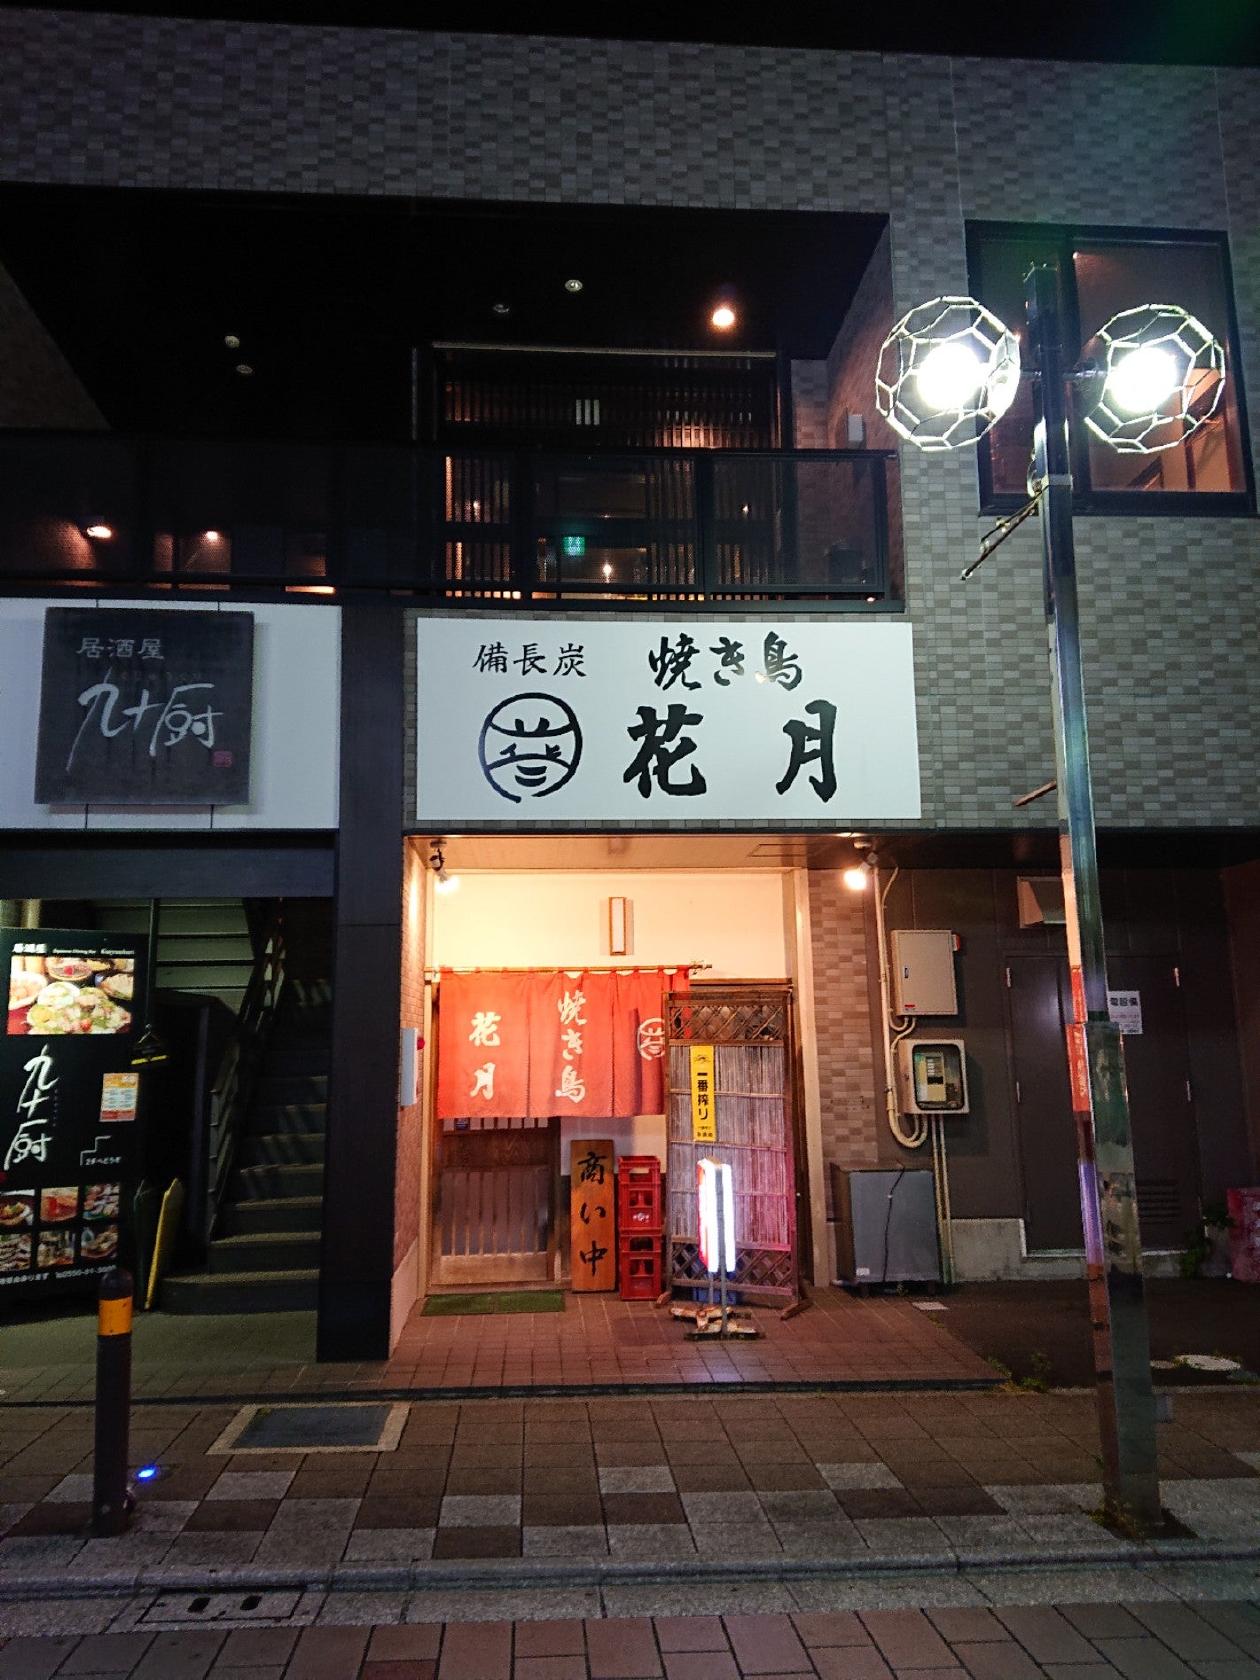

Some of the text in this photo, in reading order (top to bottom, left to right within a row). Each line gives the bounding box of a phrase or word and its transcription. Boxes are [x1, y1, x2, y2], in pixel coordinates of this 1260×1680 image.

[76, 637, 165, 660] 居酒屋
[472, 641, 587, 677] 備長炭
[648, 631, 803, 691] 焼き鳥
[622, 699, 838, 803] 花月
[470, 1012, 500, 1100] 花月
[556, 991, 588, 1103] 焼き鳥
[697, 1072, 709, 1120] 一番搾り
[579, 1152, 608, 1276] 商い中
